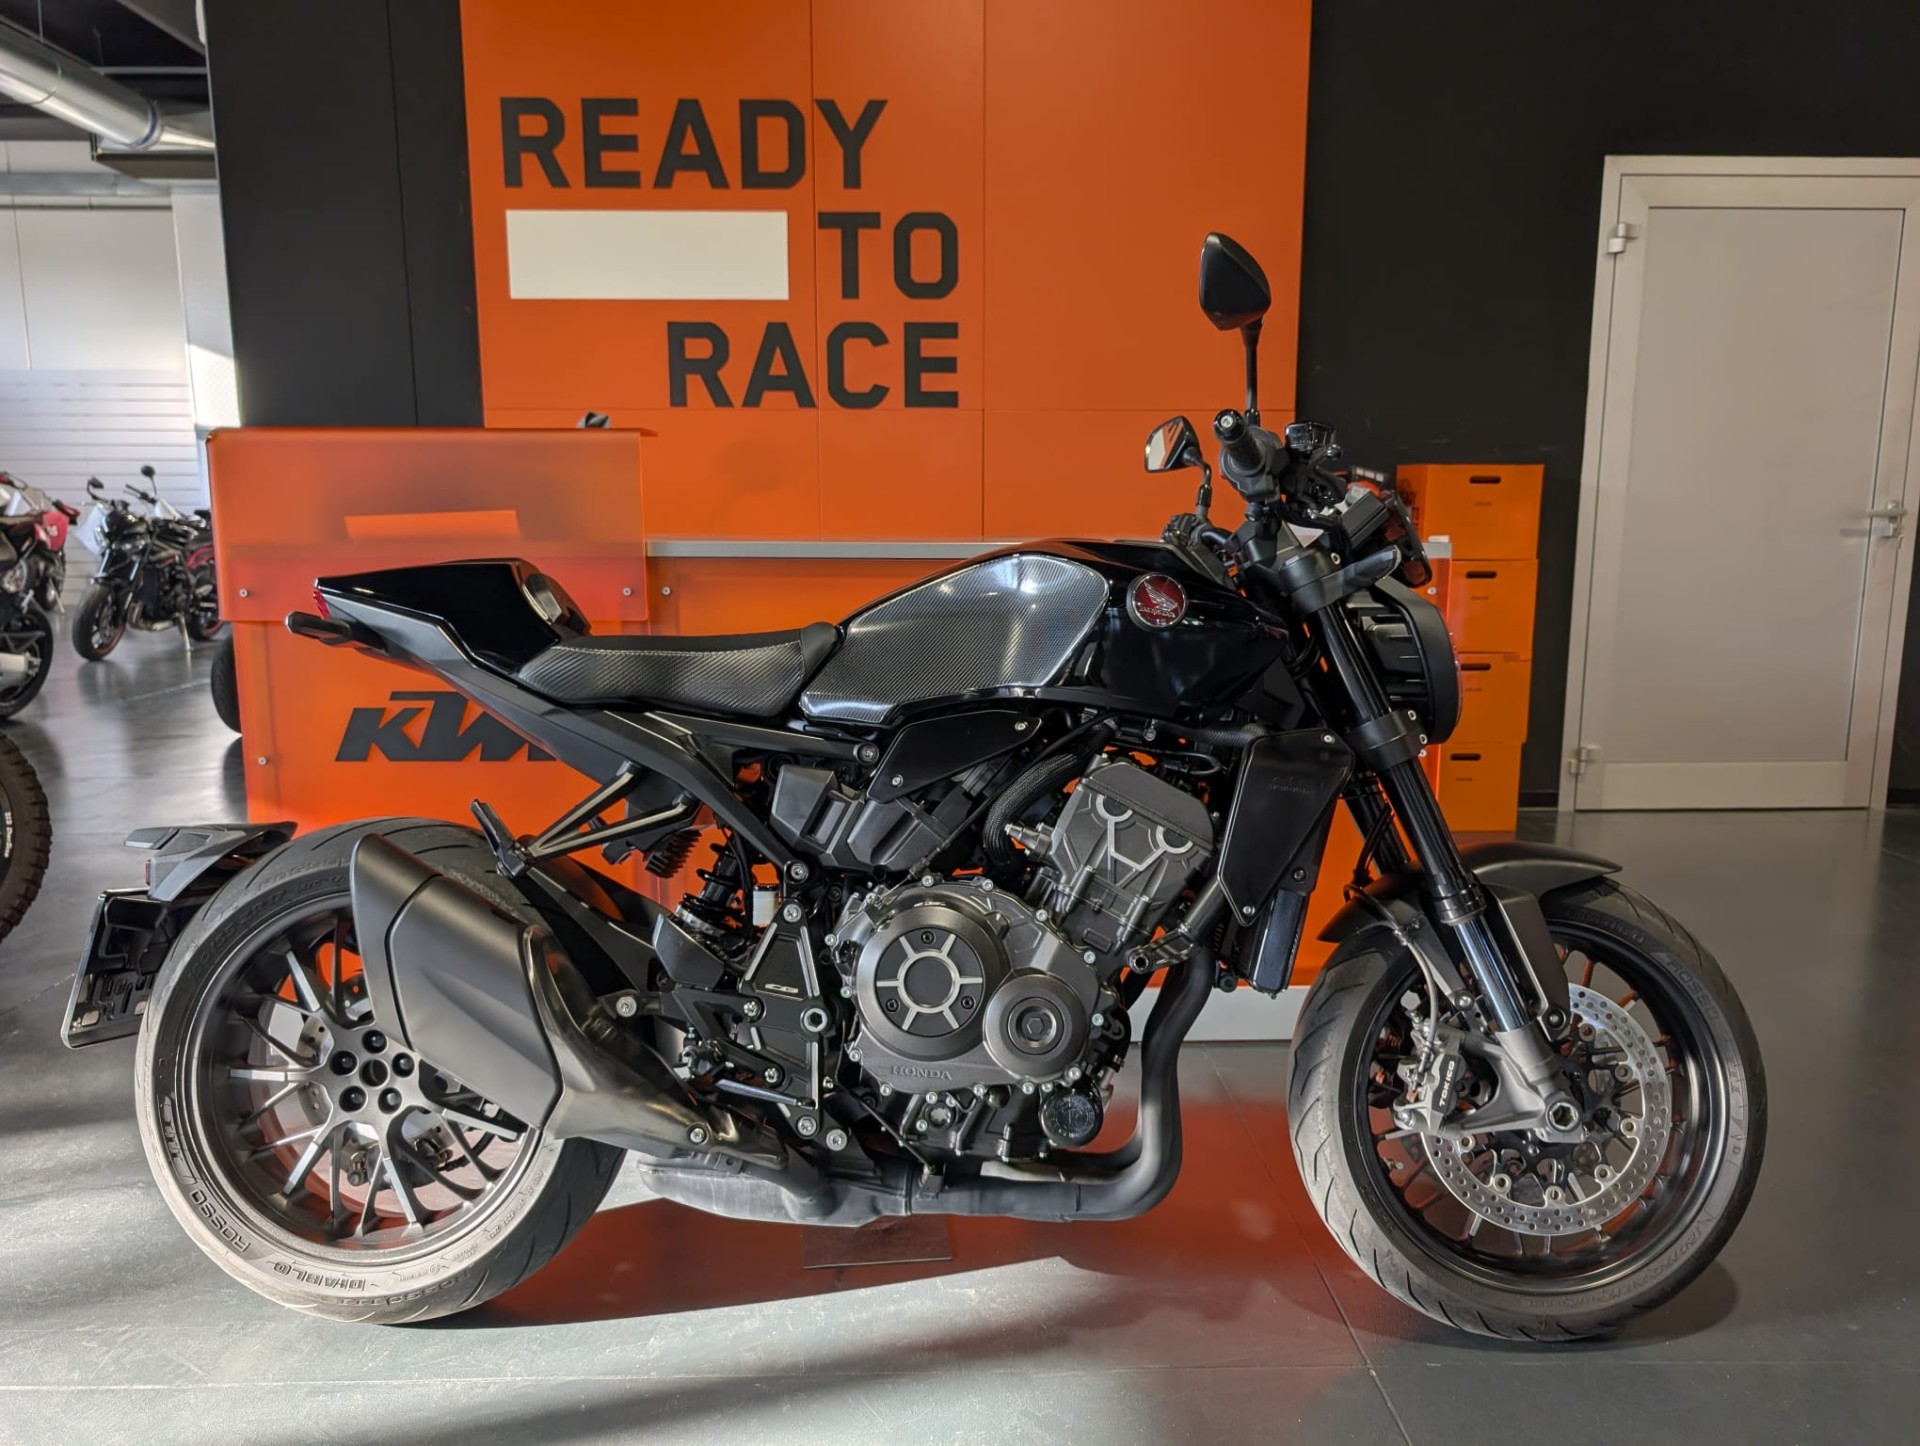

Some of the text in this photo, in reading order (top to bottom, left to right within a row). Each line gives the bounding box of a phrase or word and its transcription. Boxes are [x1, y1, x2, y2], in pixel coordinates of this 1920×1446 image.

[499, 96, 889, 190] READY
[817, 211, 959, 300] TO
[666, 321, 959, 409] RACE
[890, 1065, 953, 1081] HONDA
[1438, 1060, 1455, 1107] TOKICO
[190, 1188, 252, 1252] ROSSO
[273, 1261, 367, 1292] DIABLO
